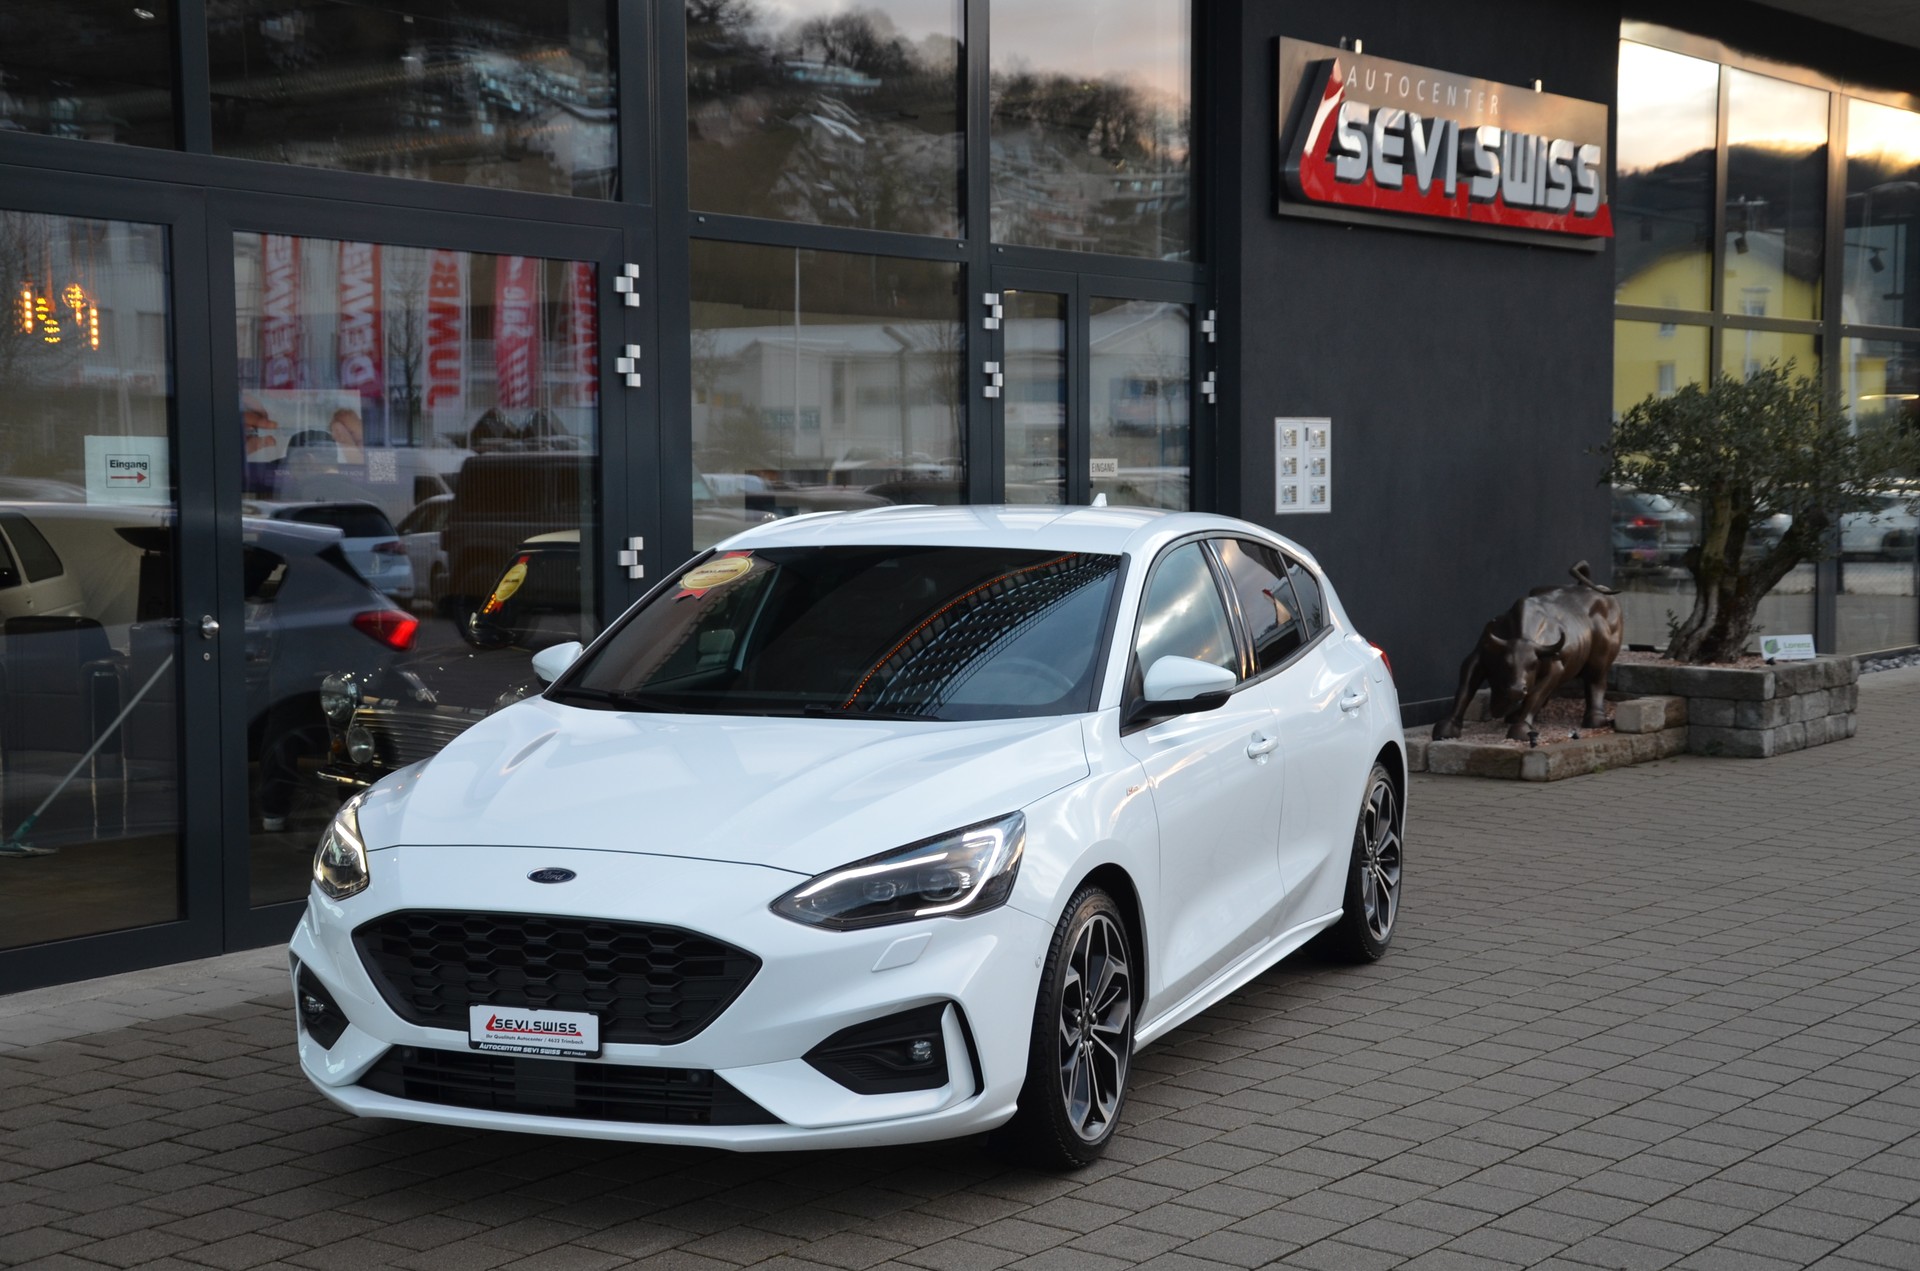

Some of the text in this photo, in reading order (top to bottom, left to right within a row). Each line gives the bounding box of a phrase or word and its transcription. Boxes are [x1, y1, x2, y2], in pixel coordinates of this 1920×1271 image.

[1346, 65, 1499, 115] AUTOCENTER
[1335, 100, 1601, 219] SEVI SWISS
[109, 459, 148, 470] Eingang
[1091, 462, 1115, 473] EINGANG
[537, 871, 566, 880] Ford
[495, 1018, 577, 1034] SEVI SWISS
[479, 1043, 522, 1051] AUTOCENTER
